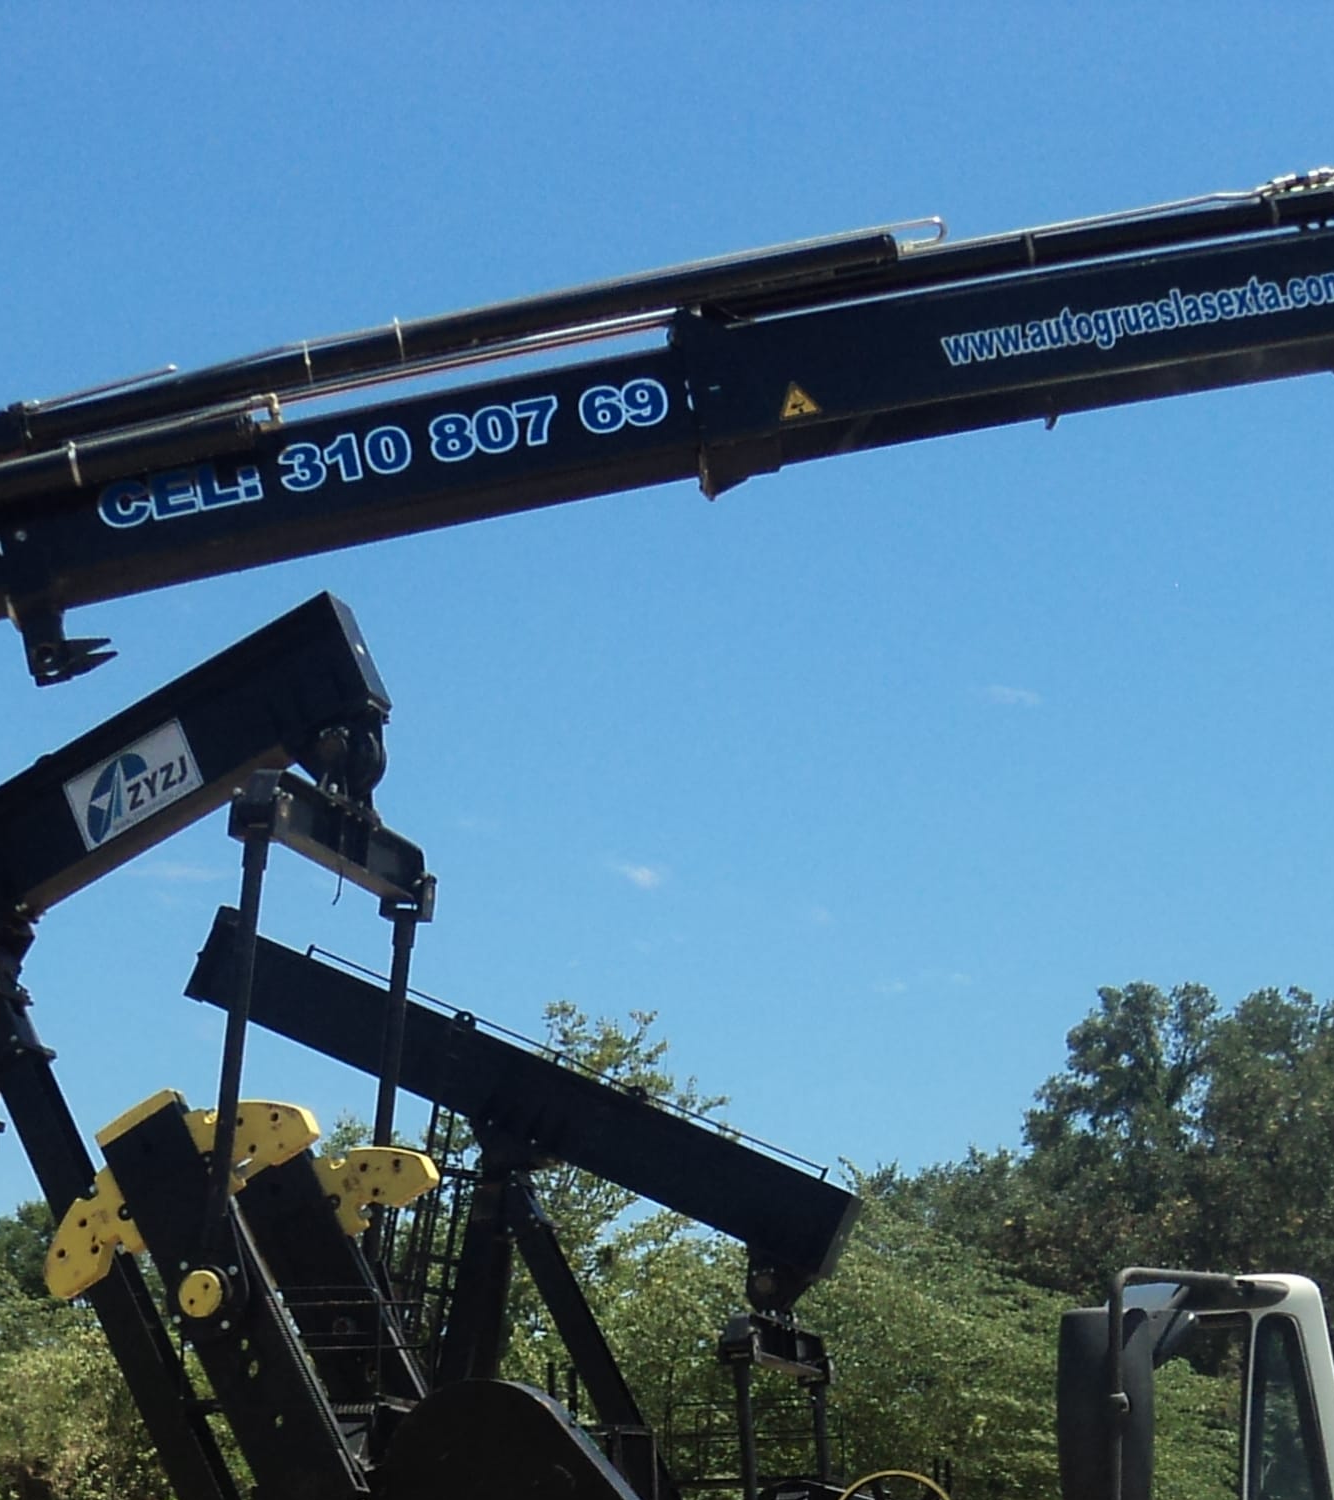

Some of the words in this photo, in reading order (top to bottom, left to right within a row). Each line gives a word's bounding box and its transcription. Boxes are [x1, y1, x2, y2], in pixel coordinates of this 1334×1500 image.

[98, 463, 264, 528] CEL:
[278, 425, 412, 492] 310
[428, 396, 558, 461] 807
[578, 378, 668, 433] 69
[127, 754, 188, 811] ZYZJ
